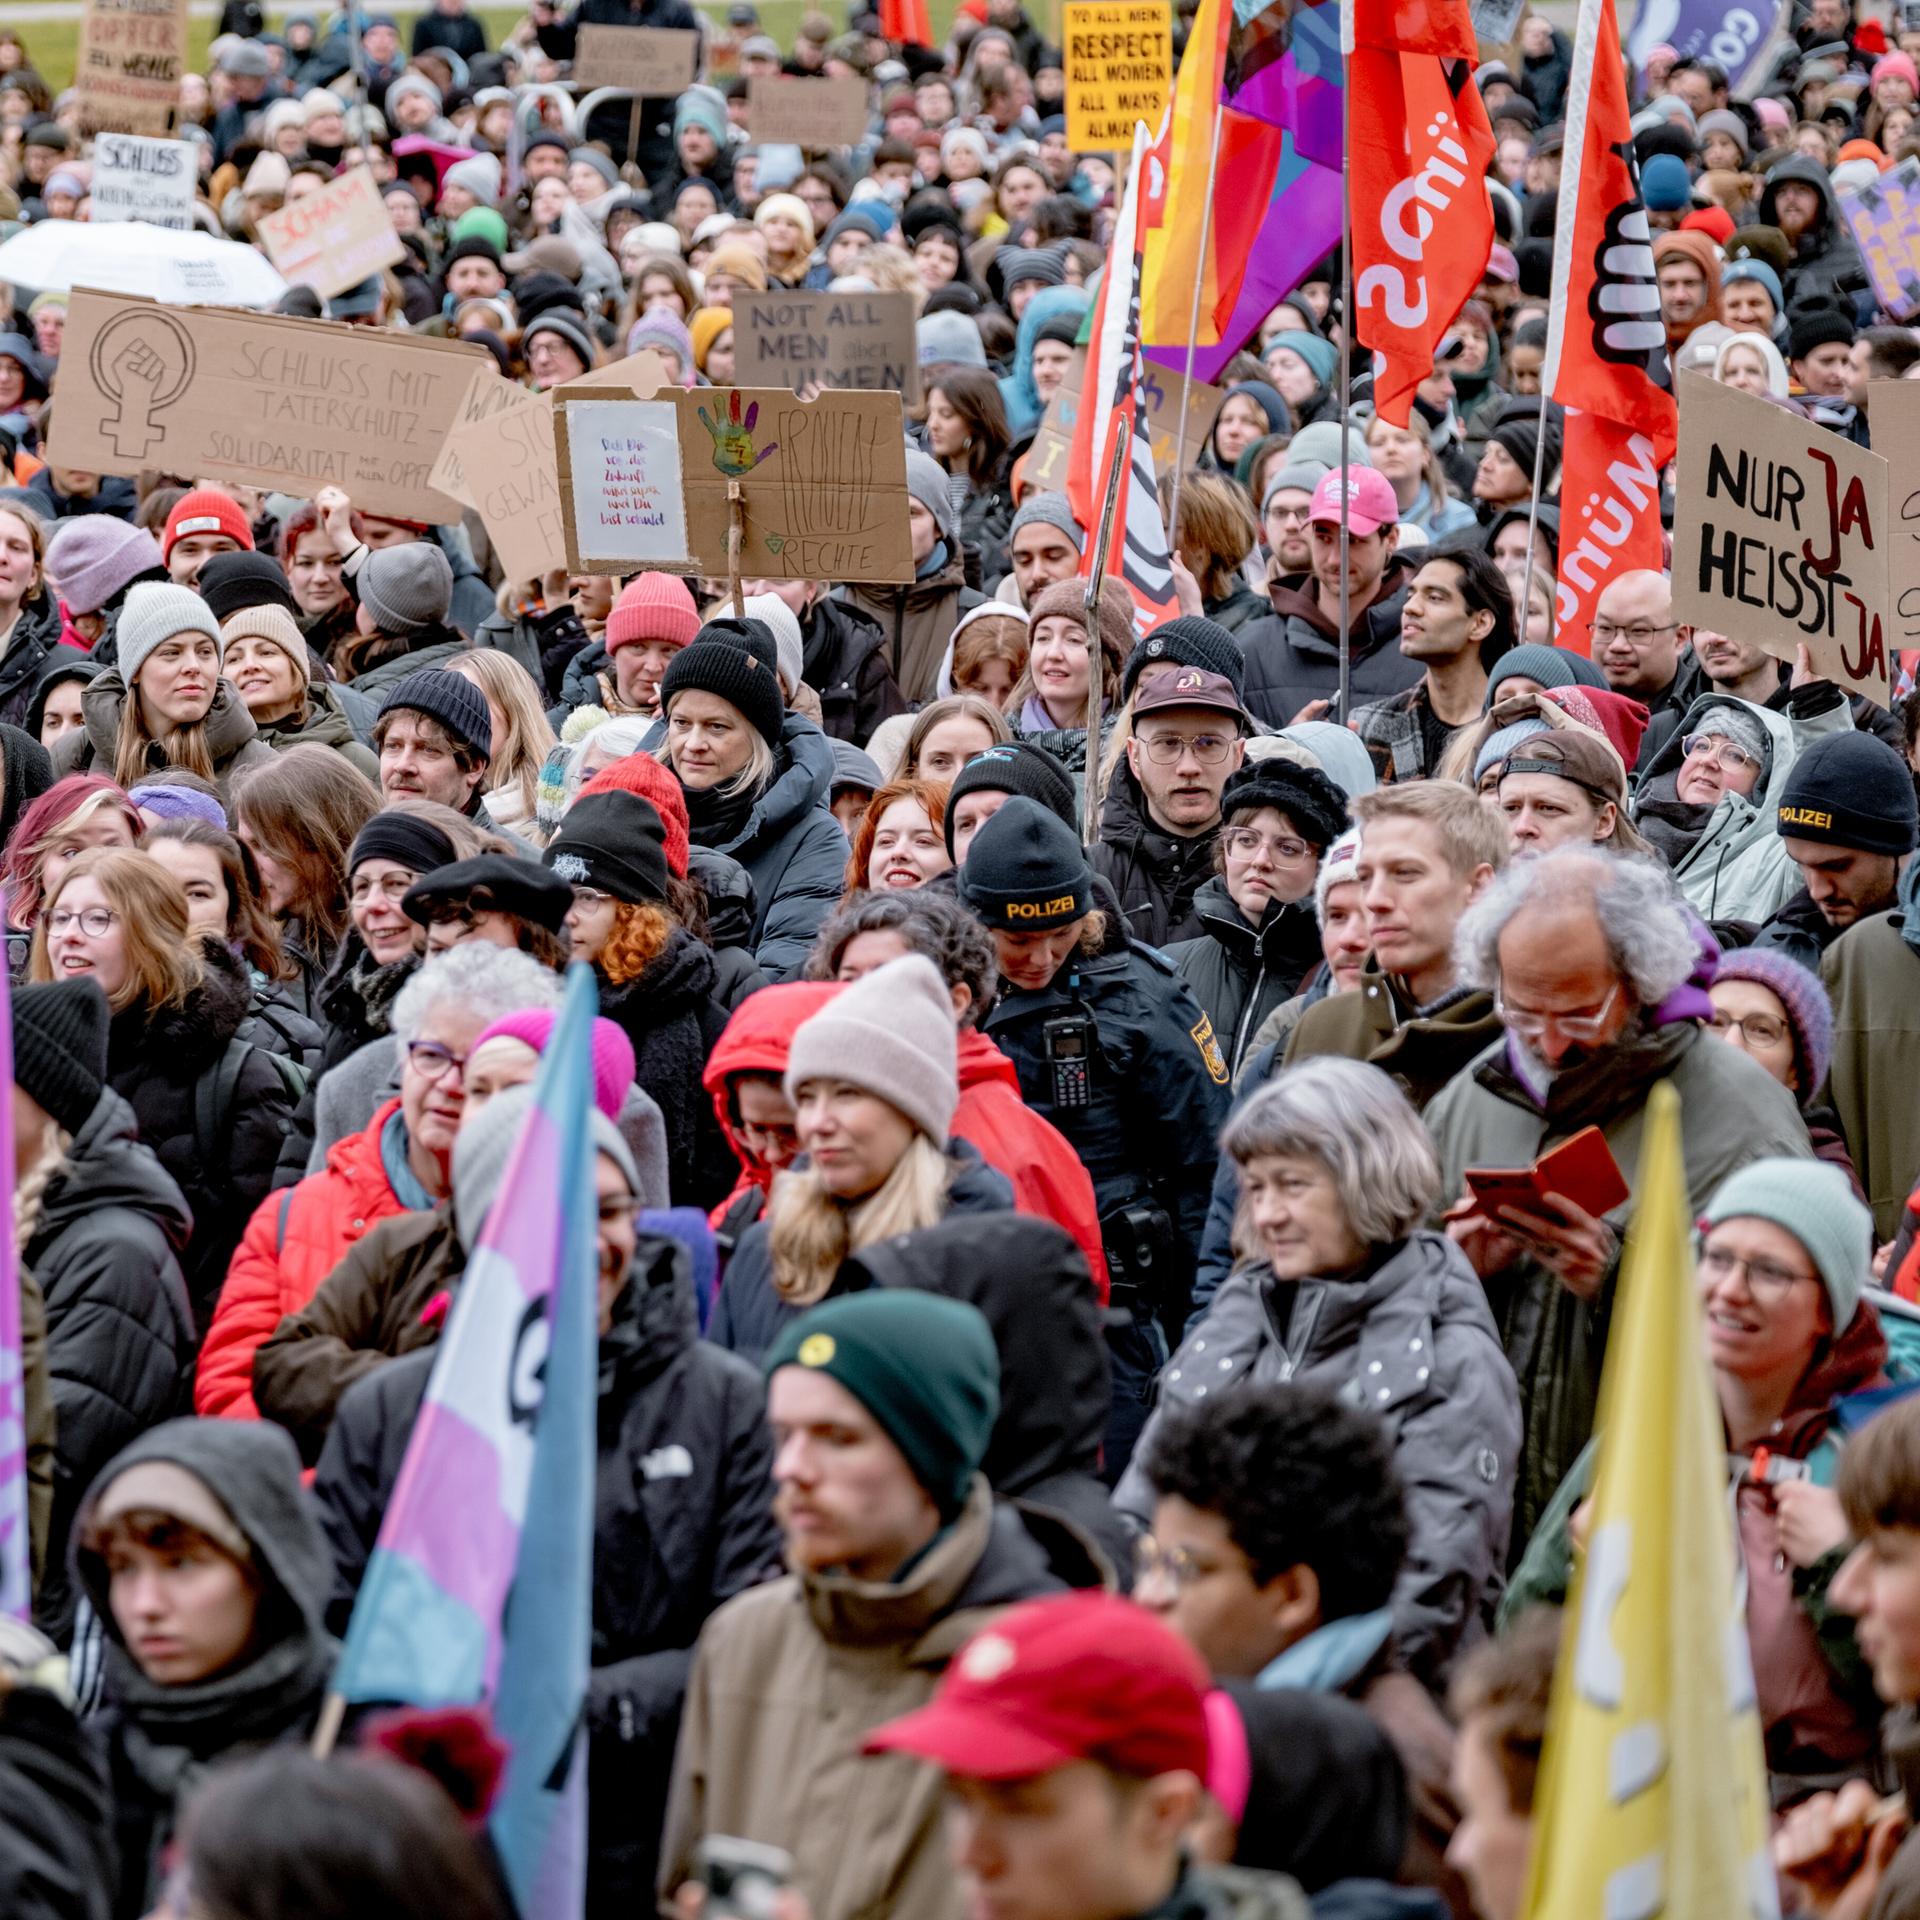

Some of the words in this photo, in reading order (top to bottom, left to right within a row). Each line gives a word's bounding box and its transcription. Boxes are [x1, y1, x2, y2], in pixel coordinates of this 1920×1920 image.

[1097, 9, 1121, 22] ALL
[1072, 31, 1164, 59] RESPECT
[1073, 66, 1098, 82] ALL
[1106, 63, 1165, 82] WOMEN
[1080, 95, 1106, 111] ALL
[1118, 92, 1162, 111] WAYS
[102, 140, 183, 177] SCHLUSS
[267, 179, 369, 251] SCHAM
[752, 303, 816, 329] NOT
[826, 302, 882, 328] ALL
[758, 334, 829, 362] MEN
[231, 340, 371, 399] SCHLUSS
[387, 368, 441, 407] MIT
[498, 403, 557, 468] STO
[604, 468, 646, 483] Zukunft
[485, 466, 558, 522] GEWA
[608, 499, 630, 510] und
[634, 497, 653, 510] Du
[600, 511, 622, 526] bist
[626, 511, 665, 526] schuld
[1706, 443, 1805, 531] NUR
[1802, 447, 1874, 575] JA
[783, 538, 876, 578] RECHTE
[1698, 522, 1853, 638] HEISST
[1840, 591, 1887, 683] JA
[1780, 806, 1832, 830] POLIZEI
[1006, 894, 1076, 920] POLIZEI
